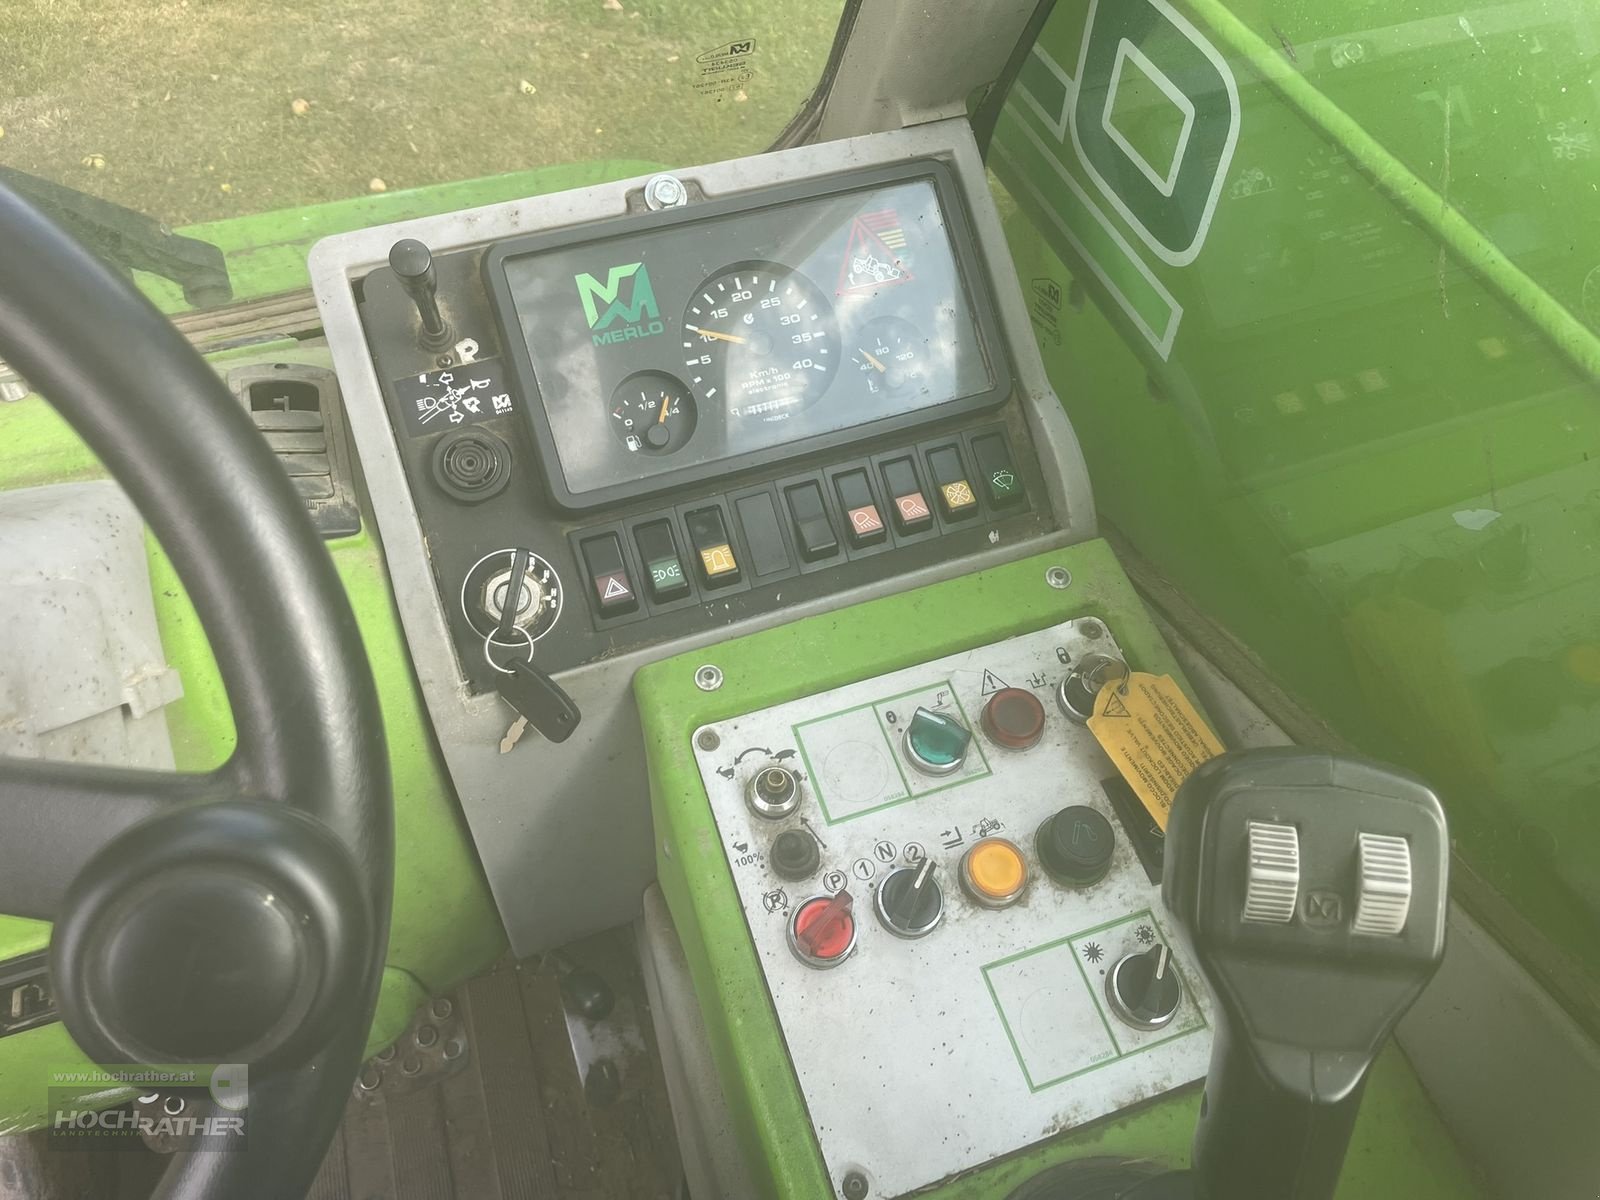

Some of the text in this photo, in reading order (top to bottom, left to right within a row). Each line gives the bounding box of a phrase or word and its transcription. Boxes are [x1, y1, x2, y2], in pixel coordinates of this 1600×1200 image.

[731, 290, 753, 303] 20
[760, 297, 782, 310] 25
[709, 308, 729, 320] 15
[780, 313, 801, 326] 30
[592, 321, 666, 347] MERLO
[791, 332, 813, 344] 35
[701, 354, 712, 365] 5
[792, 358, 813, 370] 40
[749, 367, 779, 380] Km/h
[741, 378, 765, 390] RPM
[773, 372, 792, 384] 100
[638, 400, 657, 411] 1/2
[624, 418, 633, 427] 0
[1157, 760, 1179, 789] DISABLED
[1159, 774, 1175, 793] BOOM
[1146, 783, 1167, 809] BLOCCO
[878, 844, 894, 859] N
[907, 844, 921, 860] 2
[734, 851, 764, 868] 100%
[859, 861, 868, 877] 1
[830, 874, 841, 889] P
